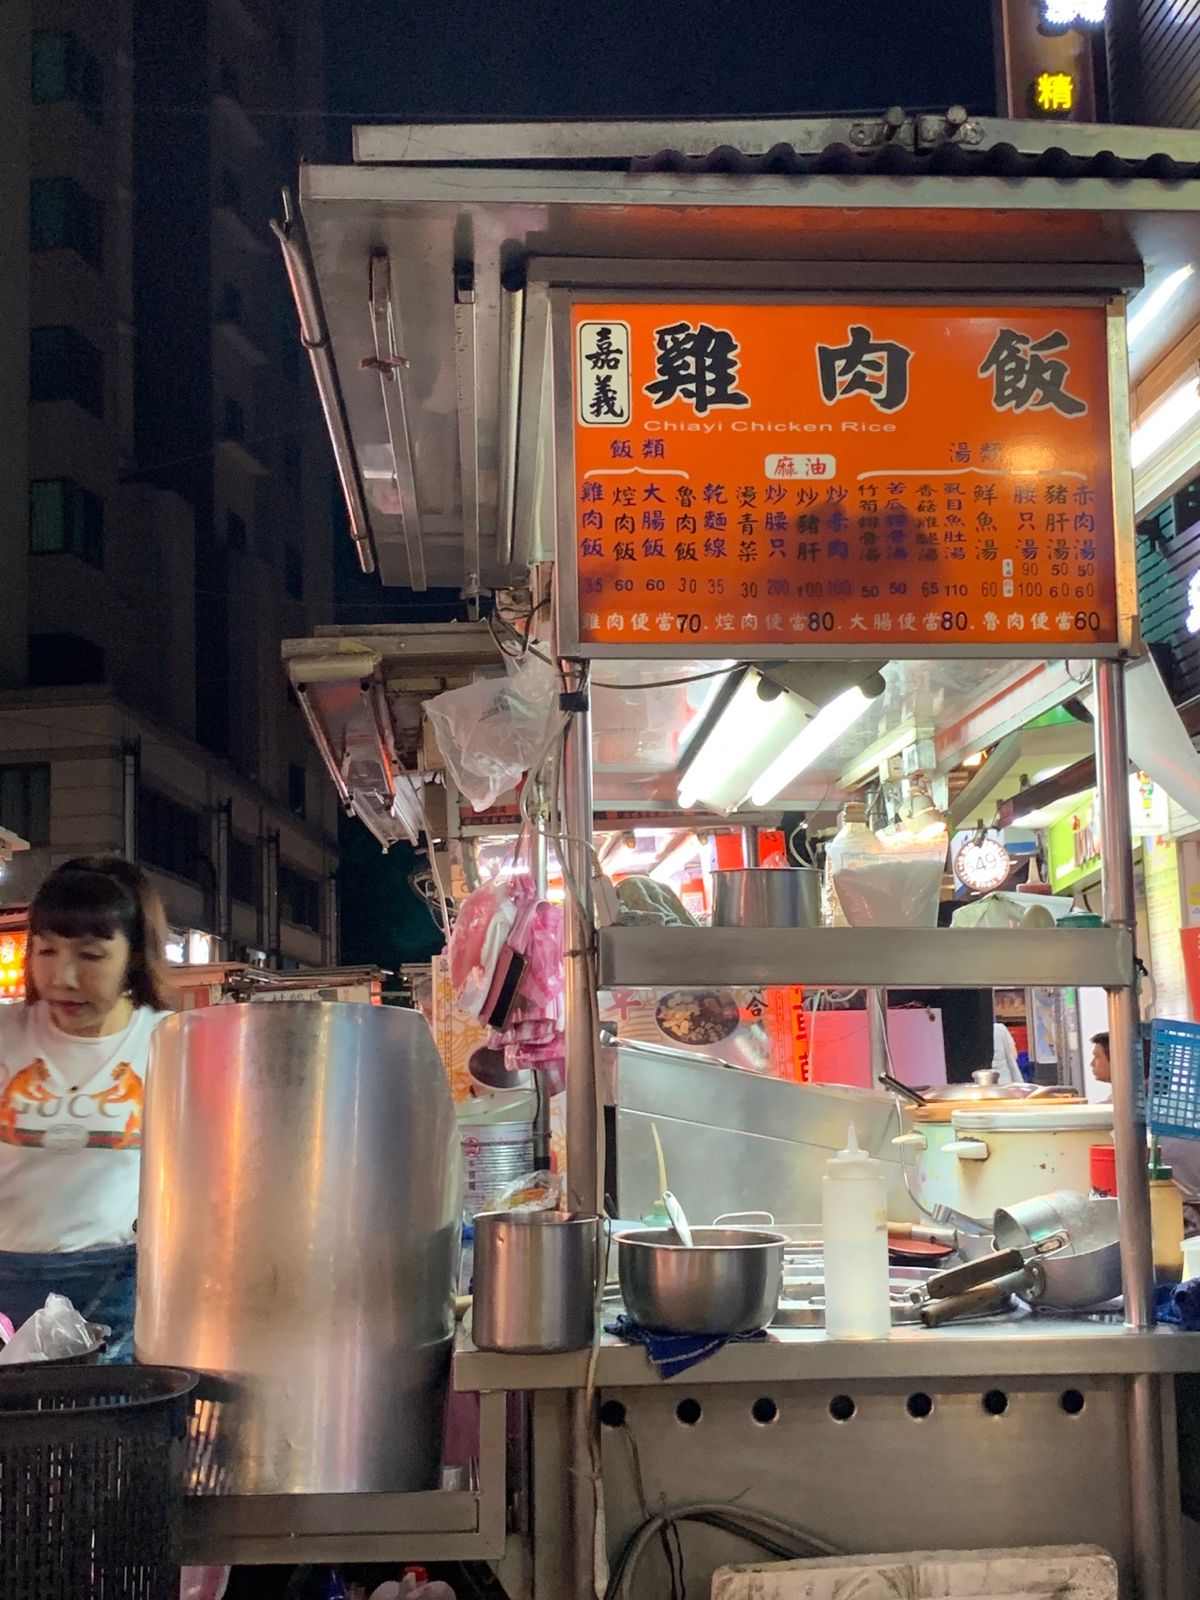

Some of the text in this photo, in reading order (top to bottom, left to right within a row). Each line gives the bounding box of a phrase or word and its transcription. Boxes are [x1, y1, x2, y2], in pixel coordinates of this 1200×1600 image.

[1037, 73, 1074, 110] 精
[585, 327, 624, 418] 嘉義
[642, 321, 1089, 419] 雞肉飯
[643, 420, 897, 433] Chiayi Chicken Rice
[610, 438, 665, 459] 飯類
[774, 456, 827, 477] 麻油
[580, 481, 604, 557] 雞肉飯
[642, 482, 666, 557] 大腸飯
[675, 485, 699, 561] 魯肉飯
[736, 486, 758, 562] 燙青菜
[765, 484, 788, 558] 炒腰只
[797, 486, 822, 562] 炒豬肝
[973, 484, 998, 561] 鮮魚湯
[1013, 484, 1040, 560] 腰只湯
[1045, 485, 1072, 560] 豬肝湯
[1073, 484, 1097, 560] 赤肉湯
[1022, 562, 1039, 576] 90
[1051, 562, 1068, 576] 50
[1077, 562, 1094, 577] 50
[614, 579, 634, 592] 60
[646, 579, 665, 592] 60
[678, 577, 697, 594] 30
[708, 578, 725, 595] 35
[741, 582, 758, 599] 30
[861, 585, 880, 598] 50
[889, 581, 907, 595] 50
[921, 581, 940, 597] 65
[945, 584, 968, 597] 110
[981, 581, 998, 597] 60
[1018, 582, 1042, 597] 100
[1050, 582, 1069, 598] 60
[1075, 582, 1094, 598] 60
